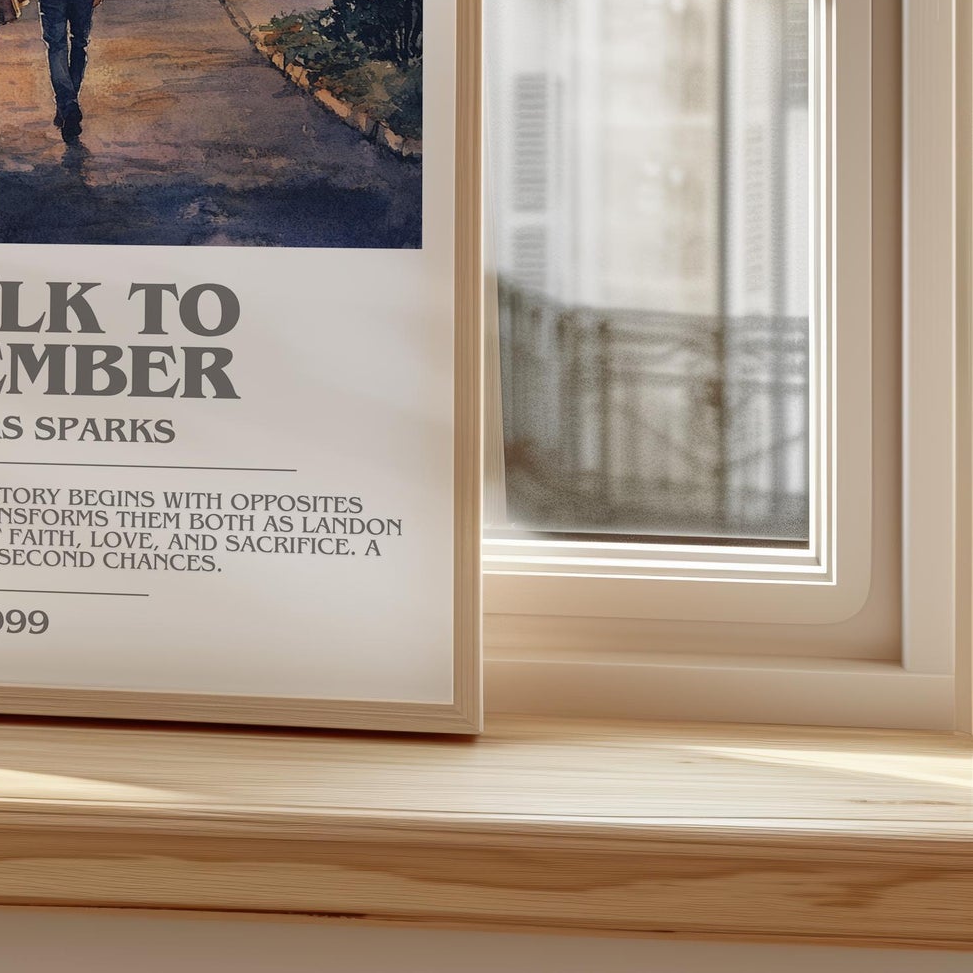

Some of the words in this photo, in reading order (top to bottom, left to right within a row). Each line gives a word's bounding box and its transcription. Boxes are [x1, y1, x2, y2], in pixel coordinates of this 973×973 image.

[128, 283, 240, 337] TO
[35, 416, 175, 443] SPARKS
[68, 489, 155, 508] BEGINS
[163, 492, 222, 510] WITH
[231, 494, 363, 514] OPPOSITES
[116, 511, 181, 529] THEM
[189, 513, 254, 531] BOTH
[262, 515, 293, 532] AS
[302, 516, 402, 536] LANDON
[9, 528, 81, 549] FAITH,
[91, 531, 159, 551] LOVE,
[167, 533, 217, 551] AND
[225, 535, 355, 555] SACRIFICE.
[365, 539, 381, 556] A
[103, 552, 221, 572] CHANCES.
